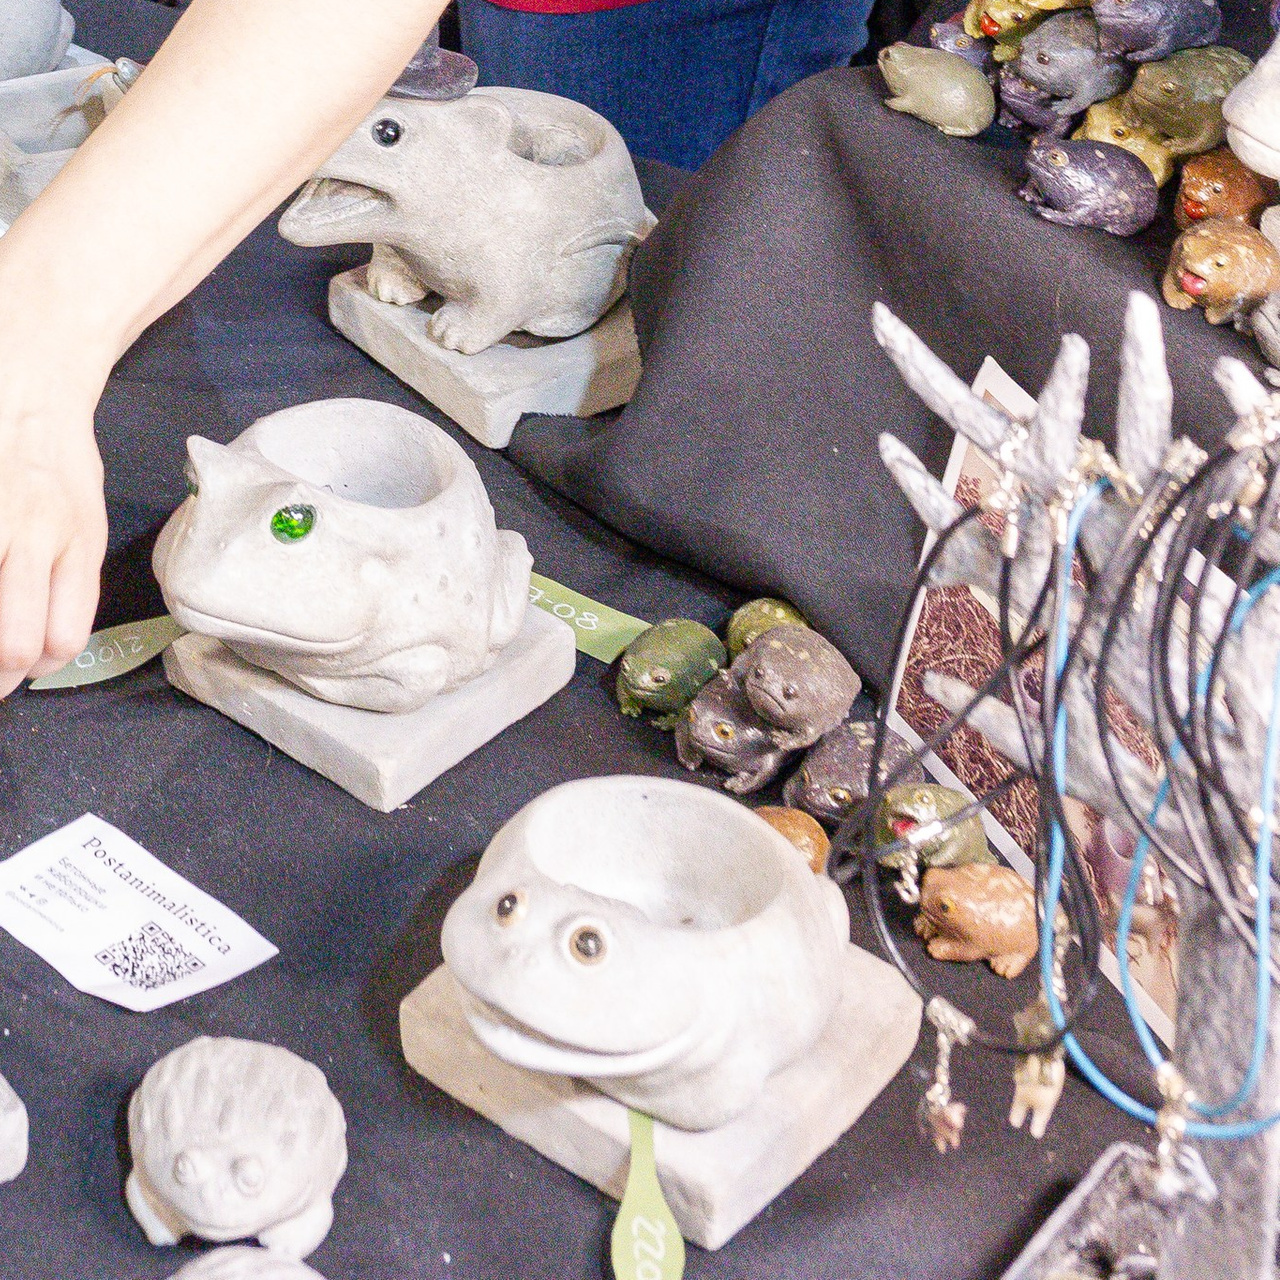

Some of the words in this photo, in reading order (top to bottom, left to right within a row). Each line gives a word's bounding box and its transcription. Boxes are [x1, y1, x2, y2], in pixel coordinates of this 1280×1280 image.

[74, 636, 144, 669] 2100
[58, 856, 107, 895] Бетонные
[81, 836, 233, 957] Postanimalistica
